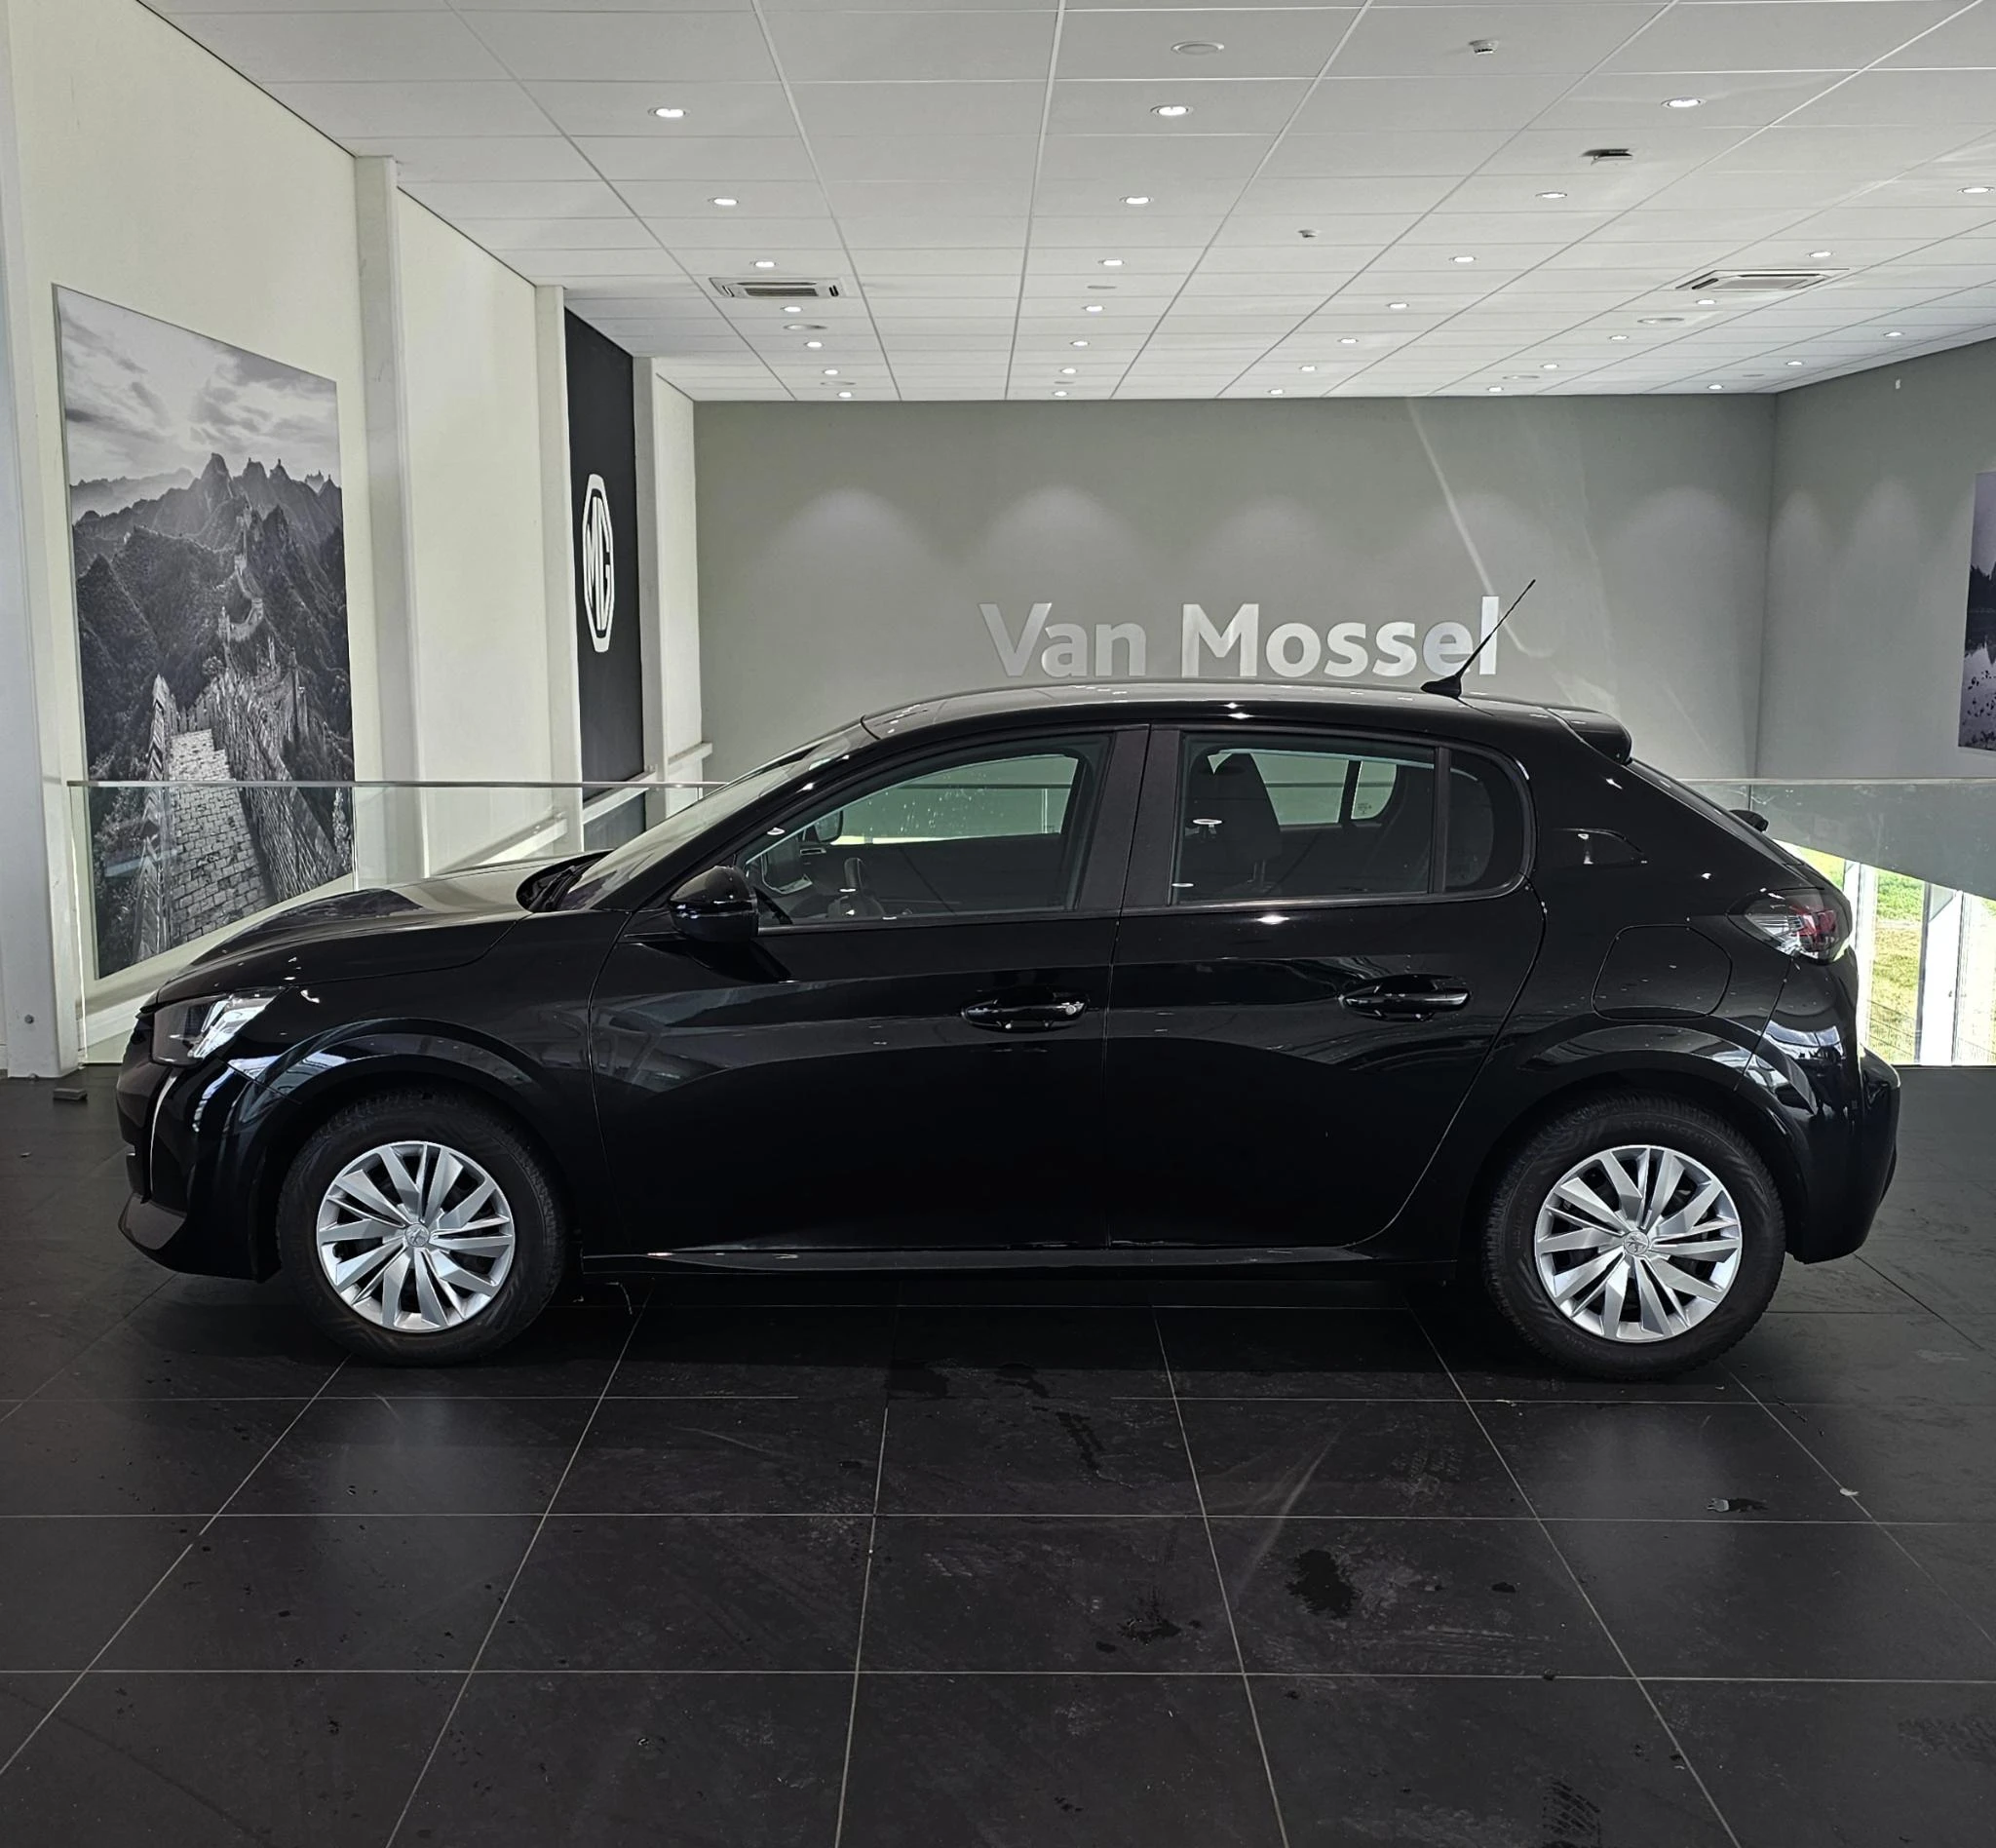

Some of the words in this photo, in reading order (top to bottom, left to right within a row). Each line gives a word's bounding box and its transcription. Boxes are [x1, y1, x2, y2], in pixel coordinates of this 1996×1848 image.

[587, 495, 611, 631] MG
[979, 602, 1146, 676] Van
[1181, 596, 1499, 677] Mossel
